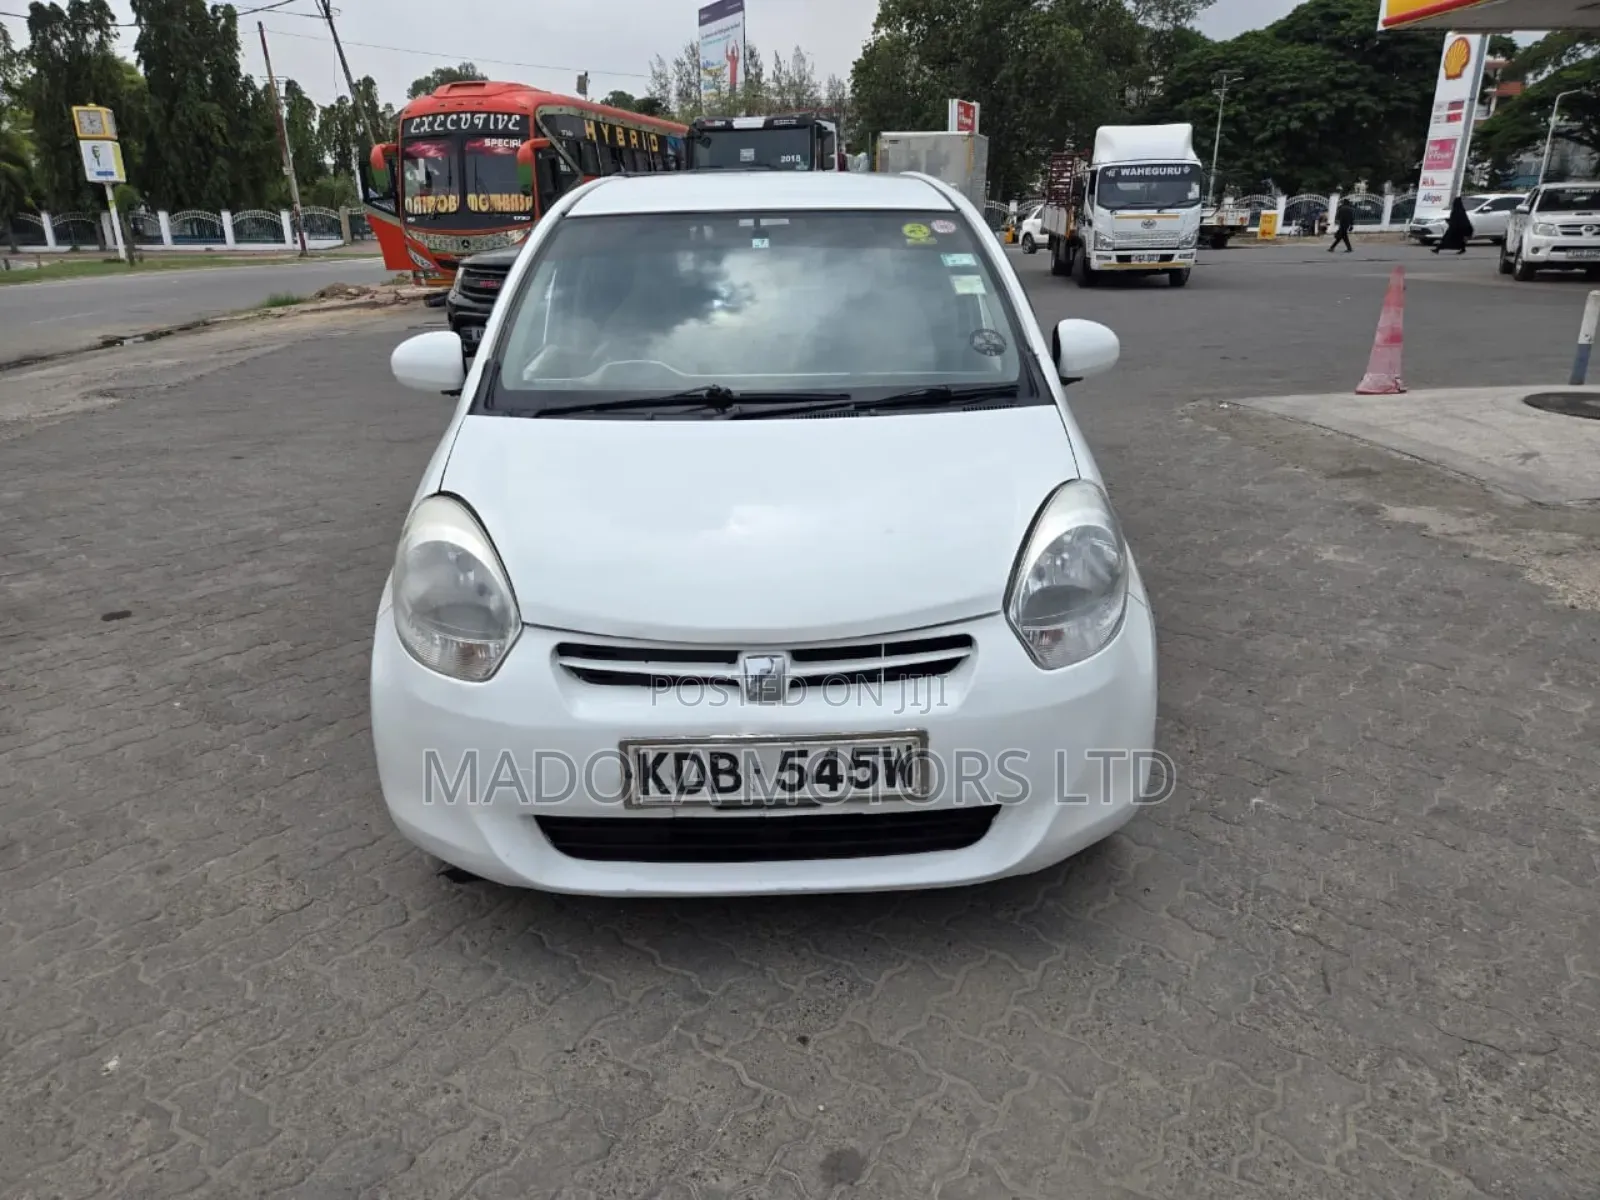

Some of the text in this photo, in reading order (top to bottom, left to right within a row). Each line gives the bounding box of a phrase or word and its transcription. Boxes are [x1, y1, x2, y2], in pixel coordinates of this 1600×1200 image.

[410, 113, 521, 133] EXECUTIVE
[484, 138, 522, 149] SPECIAL
[584, 119, 659, 152] HYBRID
[1120, 167, 1181, 176] WAHEGURU
[636, 744, 914, 796] KDB 545W
